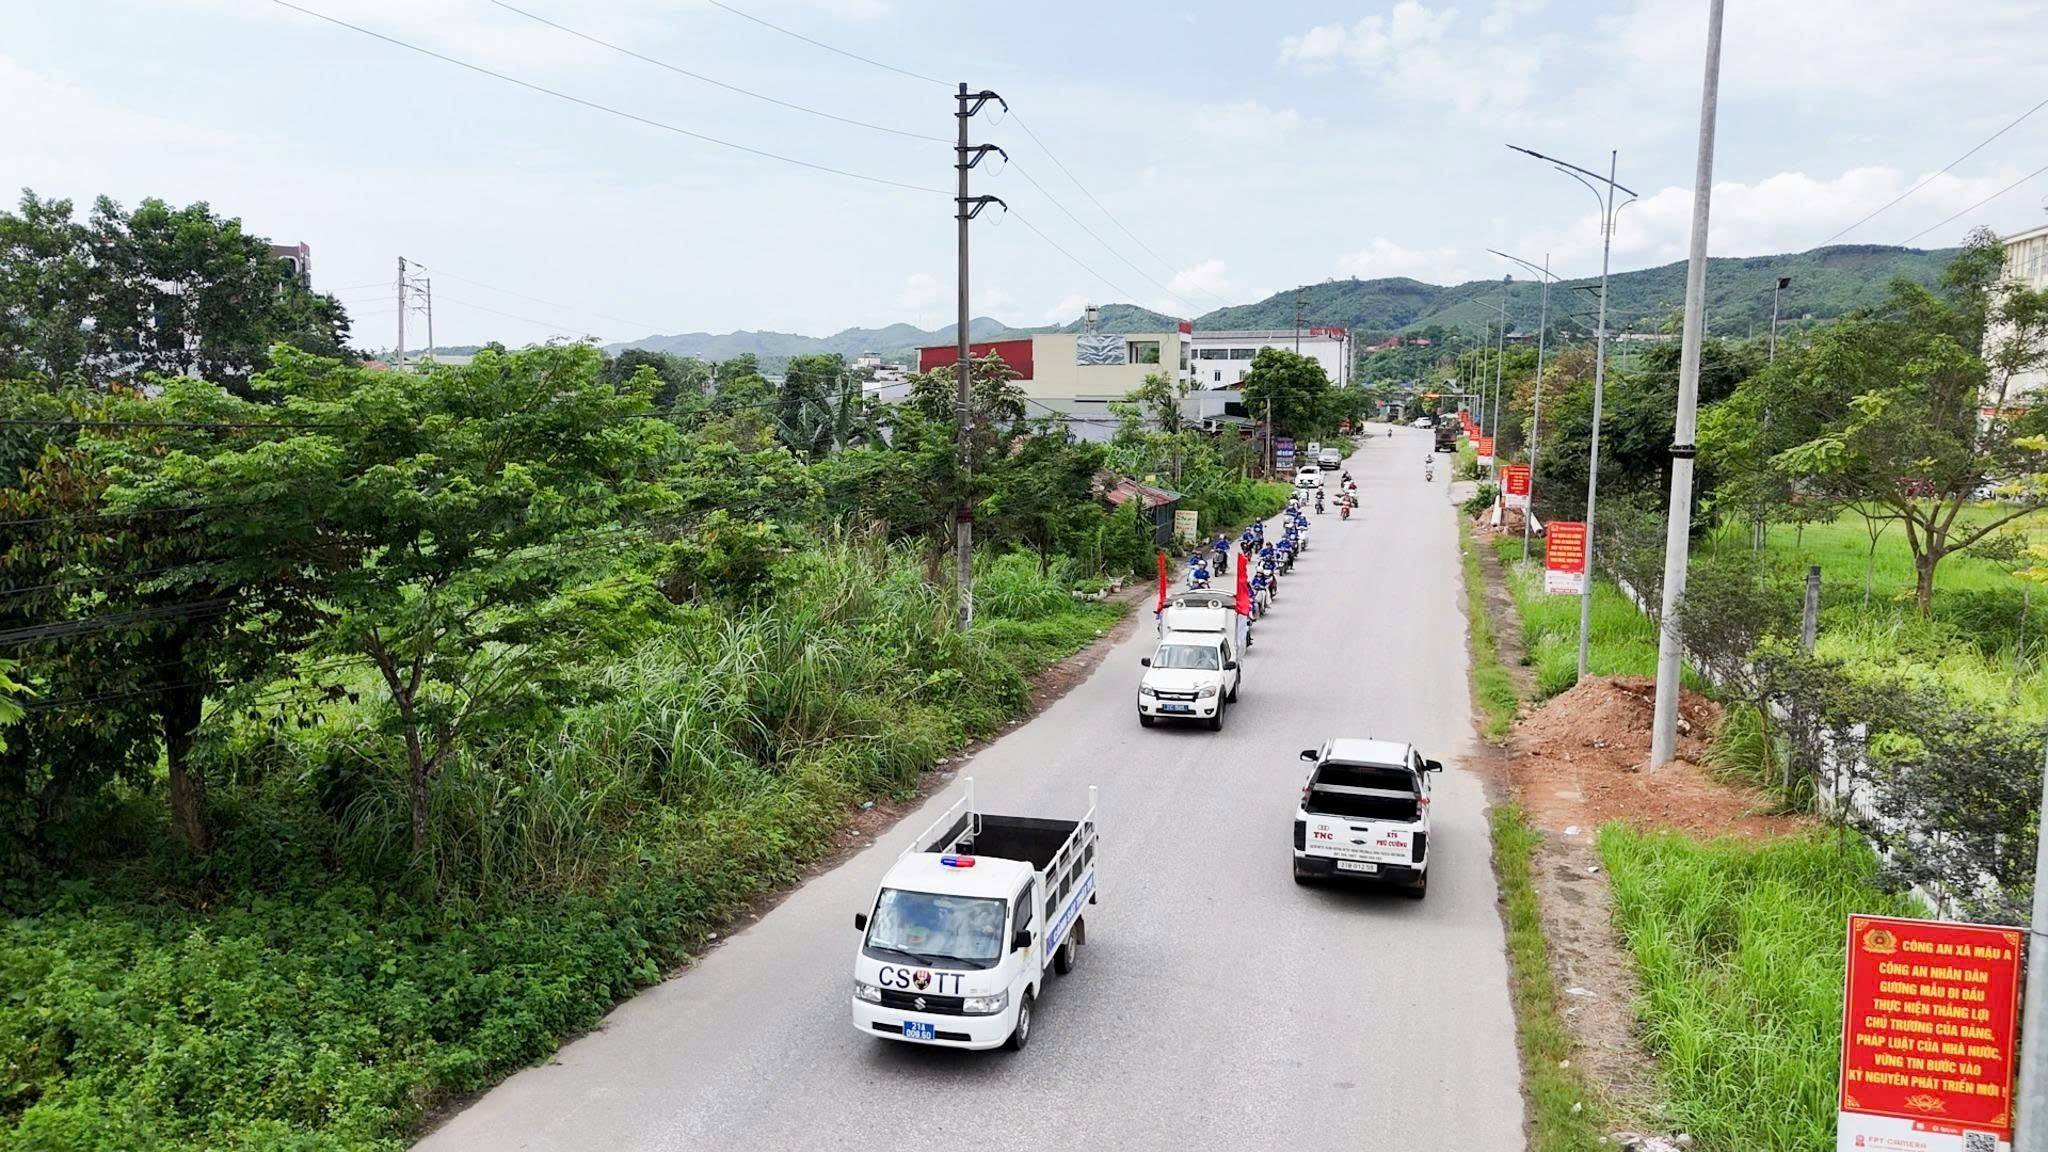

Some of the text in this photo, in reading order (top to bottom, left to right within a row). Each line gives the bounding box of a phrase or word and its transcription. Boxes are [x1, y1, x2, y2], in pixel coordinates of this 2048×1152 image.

[1902, 939, 1933, 953] CÔNG
[1936, 944, 1952, 955] AN
[2003, 949, 2012, 960] A
[880, 966, 965, 994] CS TT
[1879, 961, 1909, 975] CÔNG
[1912, 965, 1928, 977] AN
[1930, 966, 1962, 980] NHÂN
[1874, 998, 1901, 1013] THỰC
[1904, 1000, 1930, 1016] HIỆN
[1971, 1008, 1990, 1022] LỢI
[1936, 1021, 1958, 1036] CỦA
[1856, 1033, 1885, 1046] PHÁP
[1888, 1036, 1915, 1052] LUẬT
[1917, 1038, 1939, 1053] CỦA
[1907, 1057, 1924, 1070] TIN
[1960, 1061, 1981, 1076] VÀO
[1865, 1071, 1908, 1087] NGUYÊN
[1911, 1076, 1940, 1089] PHÁT
